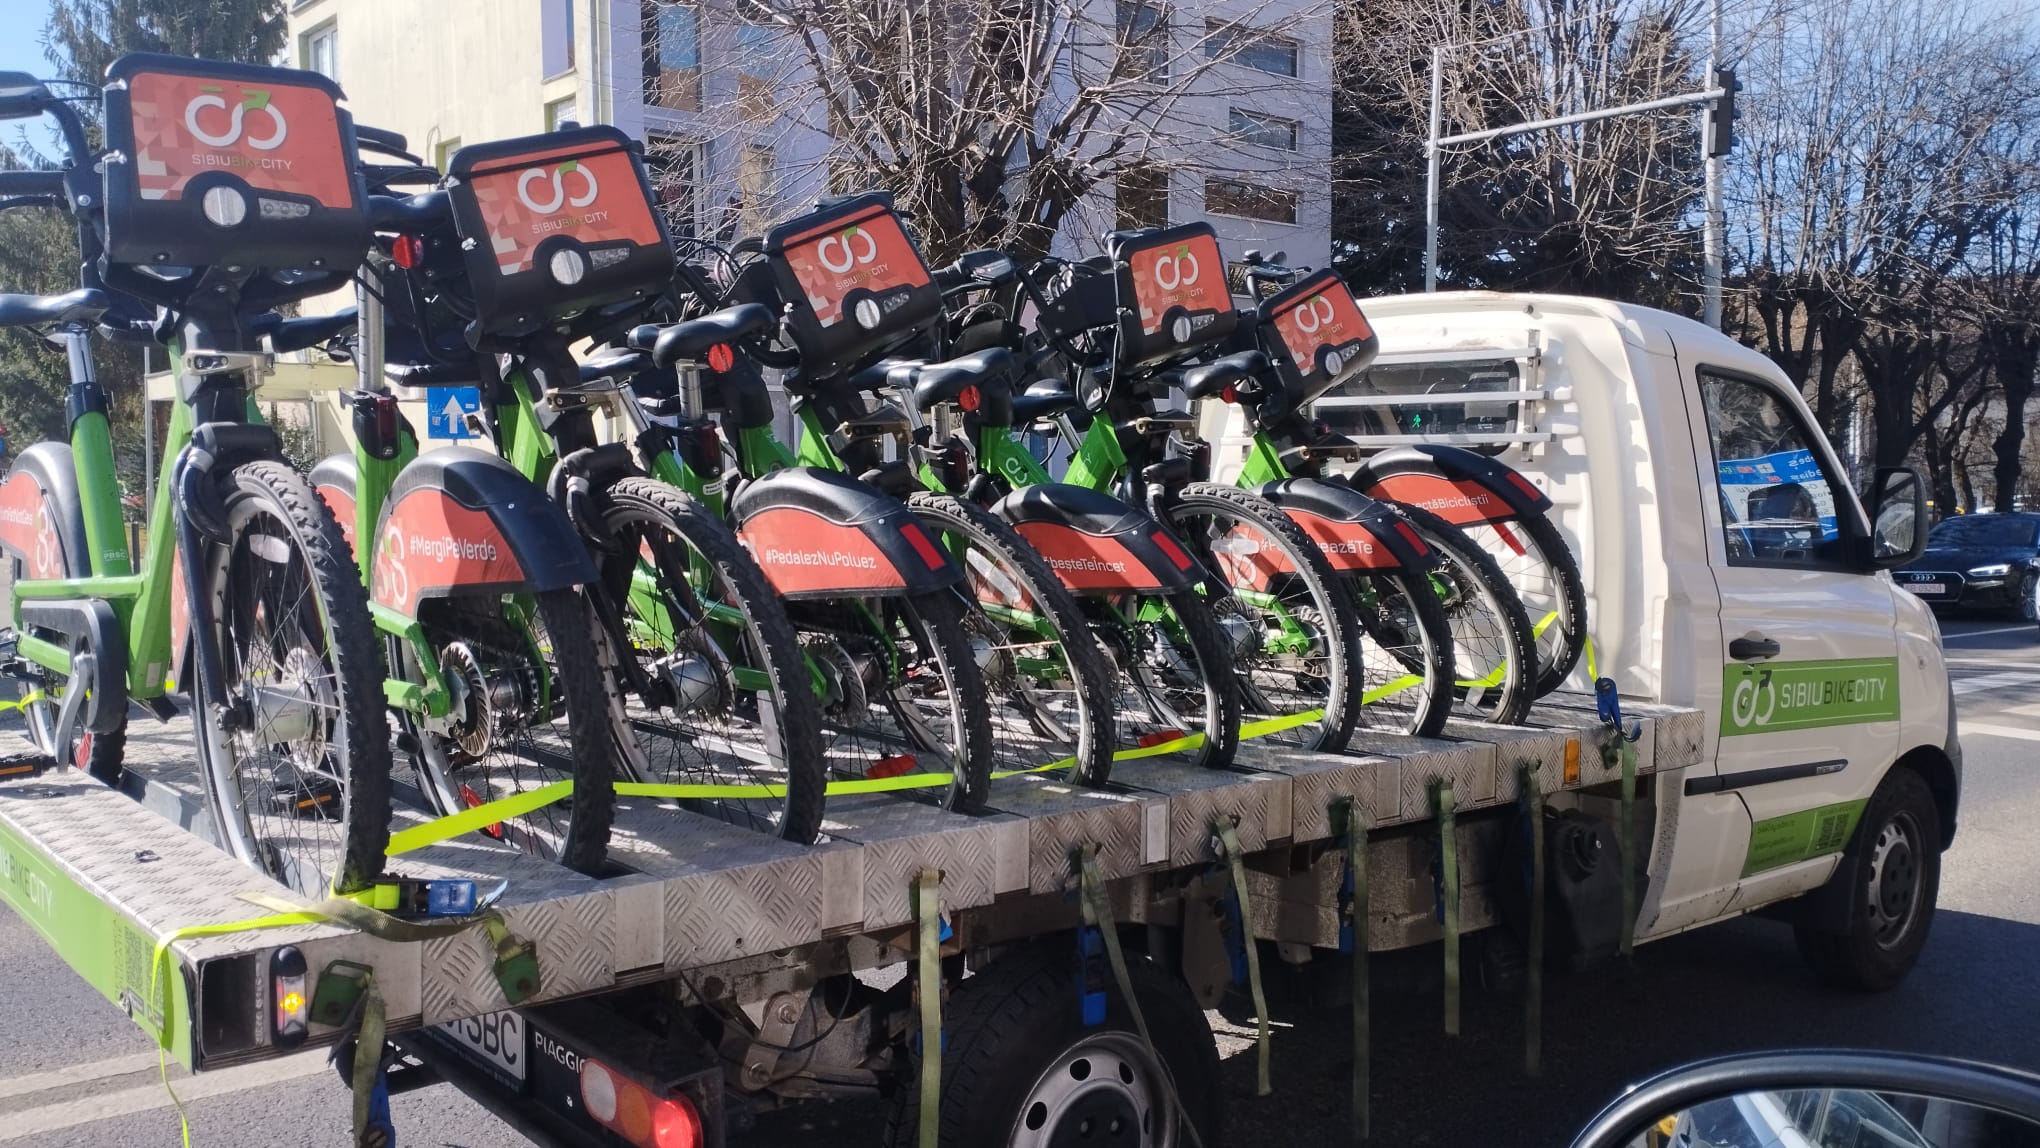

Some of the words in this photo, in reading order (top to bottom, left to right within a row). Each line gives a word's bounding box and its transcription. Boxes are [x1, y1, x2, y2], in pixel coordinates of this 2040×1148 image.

[191, 153, 293, 171] SIBIUBIKECITY
[531, 210, 609, 234] SIBIUBIKECITY
[409, 535, 497, 563] #MergiPeVerde
[765, 549, 877, 569] #PedalezNuPoluez
[1043, 556, 1127, 573] beșteTeÎncet
[1780, 677, 1887, 708] SIBIUBIKECITY
